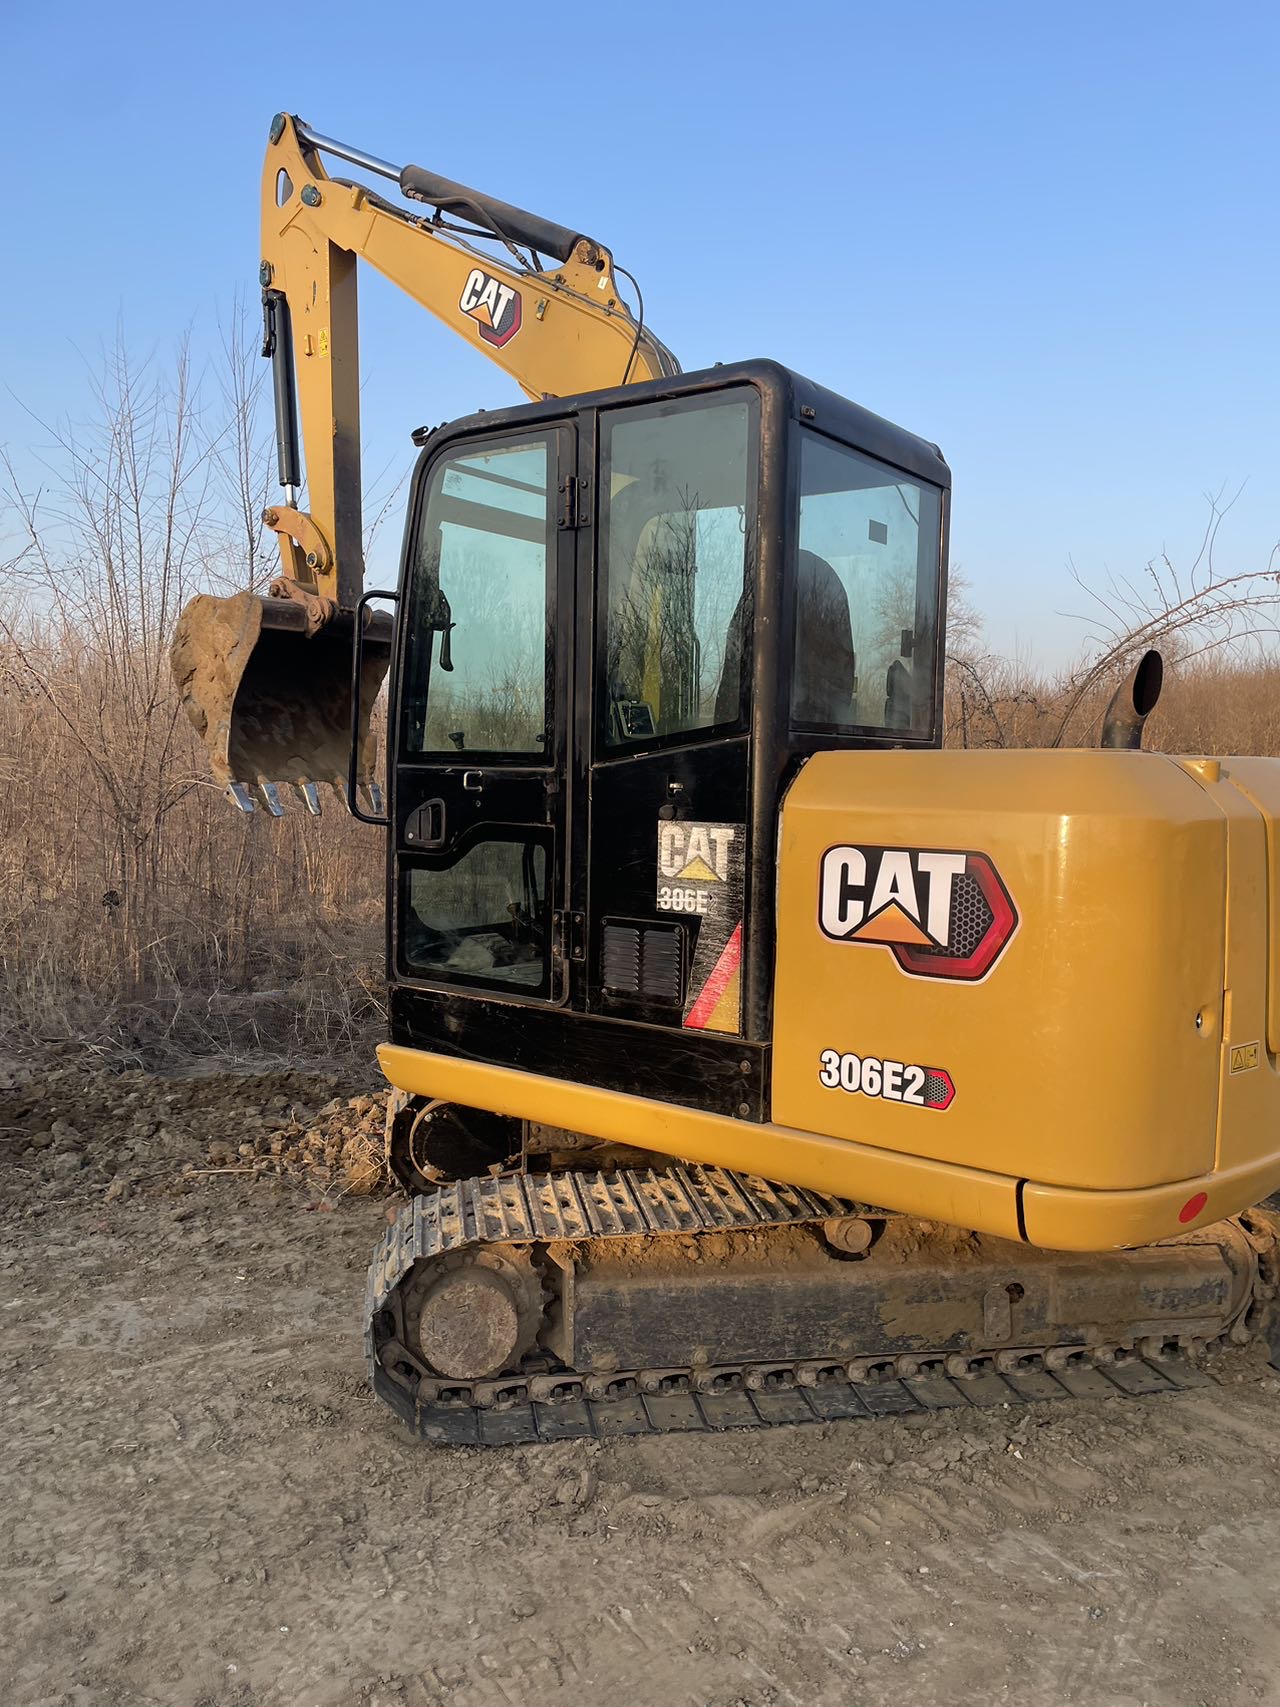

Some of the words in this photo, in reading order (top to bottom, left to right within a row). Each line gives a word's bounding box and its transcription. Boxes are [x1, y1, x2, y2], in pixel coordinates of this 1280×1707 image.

[461, 269, 516, 330] CAT
[661, 823, 735, 882] CAT
[822, 846, 967, 946] CAT
[820, 1049, 926, 1105] 306E2
